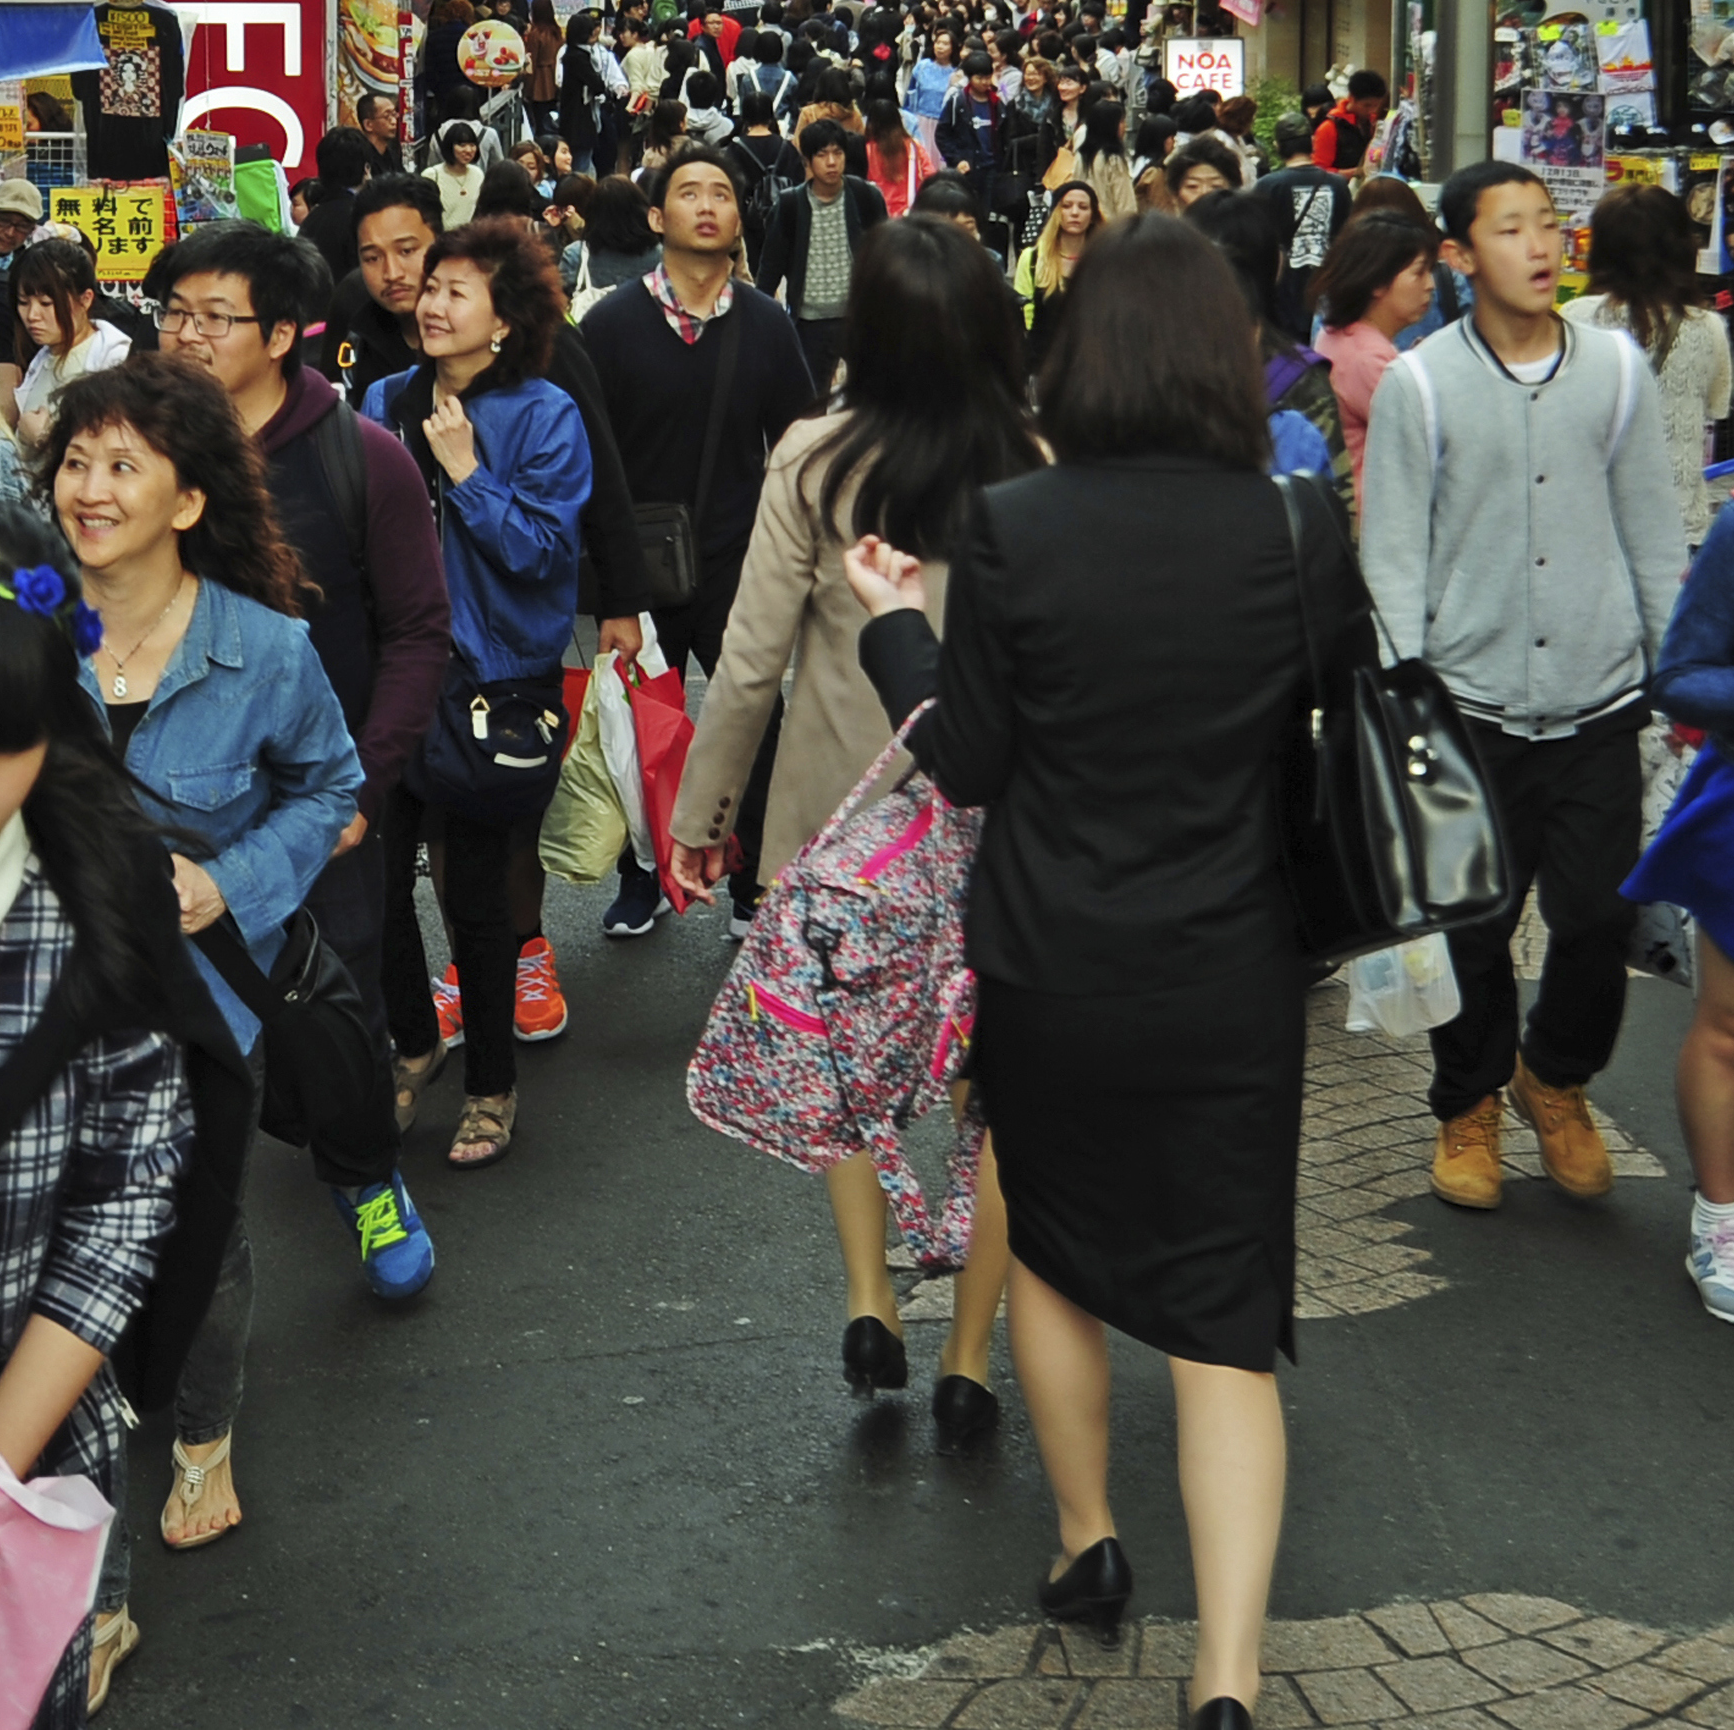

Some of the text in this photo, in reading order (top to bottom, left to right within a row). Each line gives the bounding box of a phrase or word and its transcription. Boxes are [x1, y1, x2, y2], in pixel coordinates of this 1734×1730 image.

[1177, 52, 1232, 71] NOA
[1176, 72, 1233, 90] CAFE
[55, 197, 153, 216] 無料で
